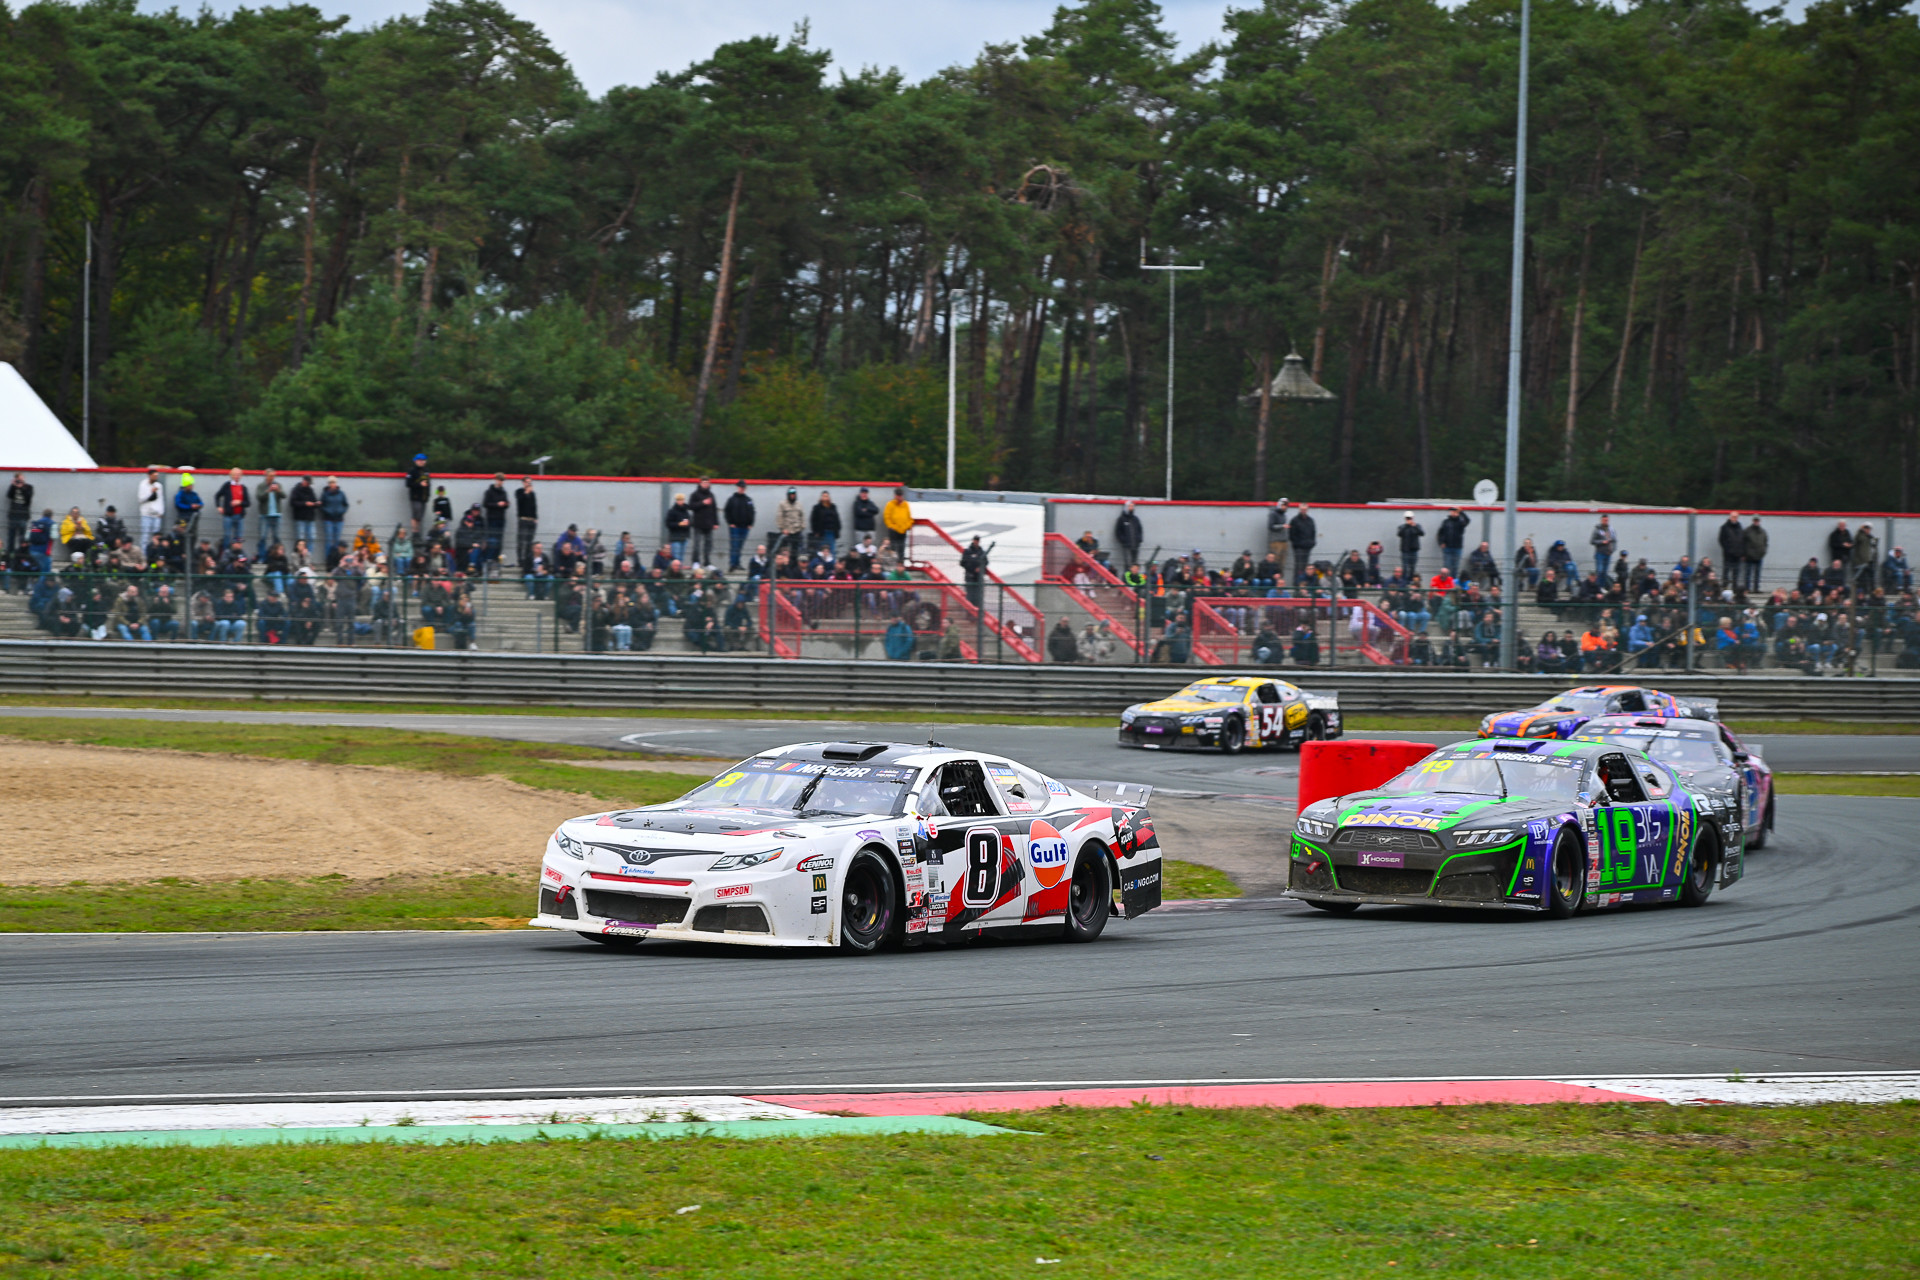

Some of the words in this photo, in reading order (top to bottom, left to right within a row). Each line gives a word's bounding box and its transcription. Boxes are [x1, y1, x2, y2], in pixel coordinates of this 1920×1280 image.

[1262, 706, 1283, 738] 54
[1421, 759, 1454, 774] 19
[1490, 752, 1548, 763] NASCAR
[714, 771, 745, 788] 8
[796, 763, 871, 778] NASCAR
[1340, 812, 1442, 831] DINOIL
[1597, 808, 1637, 885] 19
[1674, 809, 1690, 877] DINOIL
[1030, 842, 1067, 863] Gulf
[800, 858, 834, 870] KENNOL
[963, 827, 1001, 907] 8
[716, 885, 750, 898] SIMPSON
